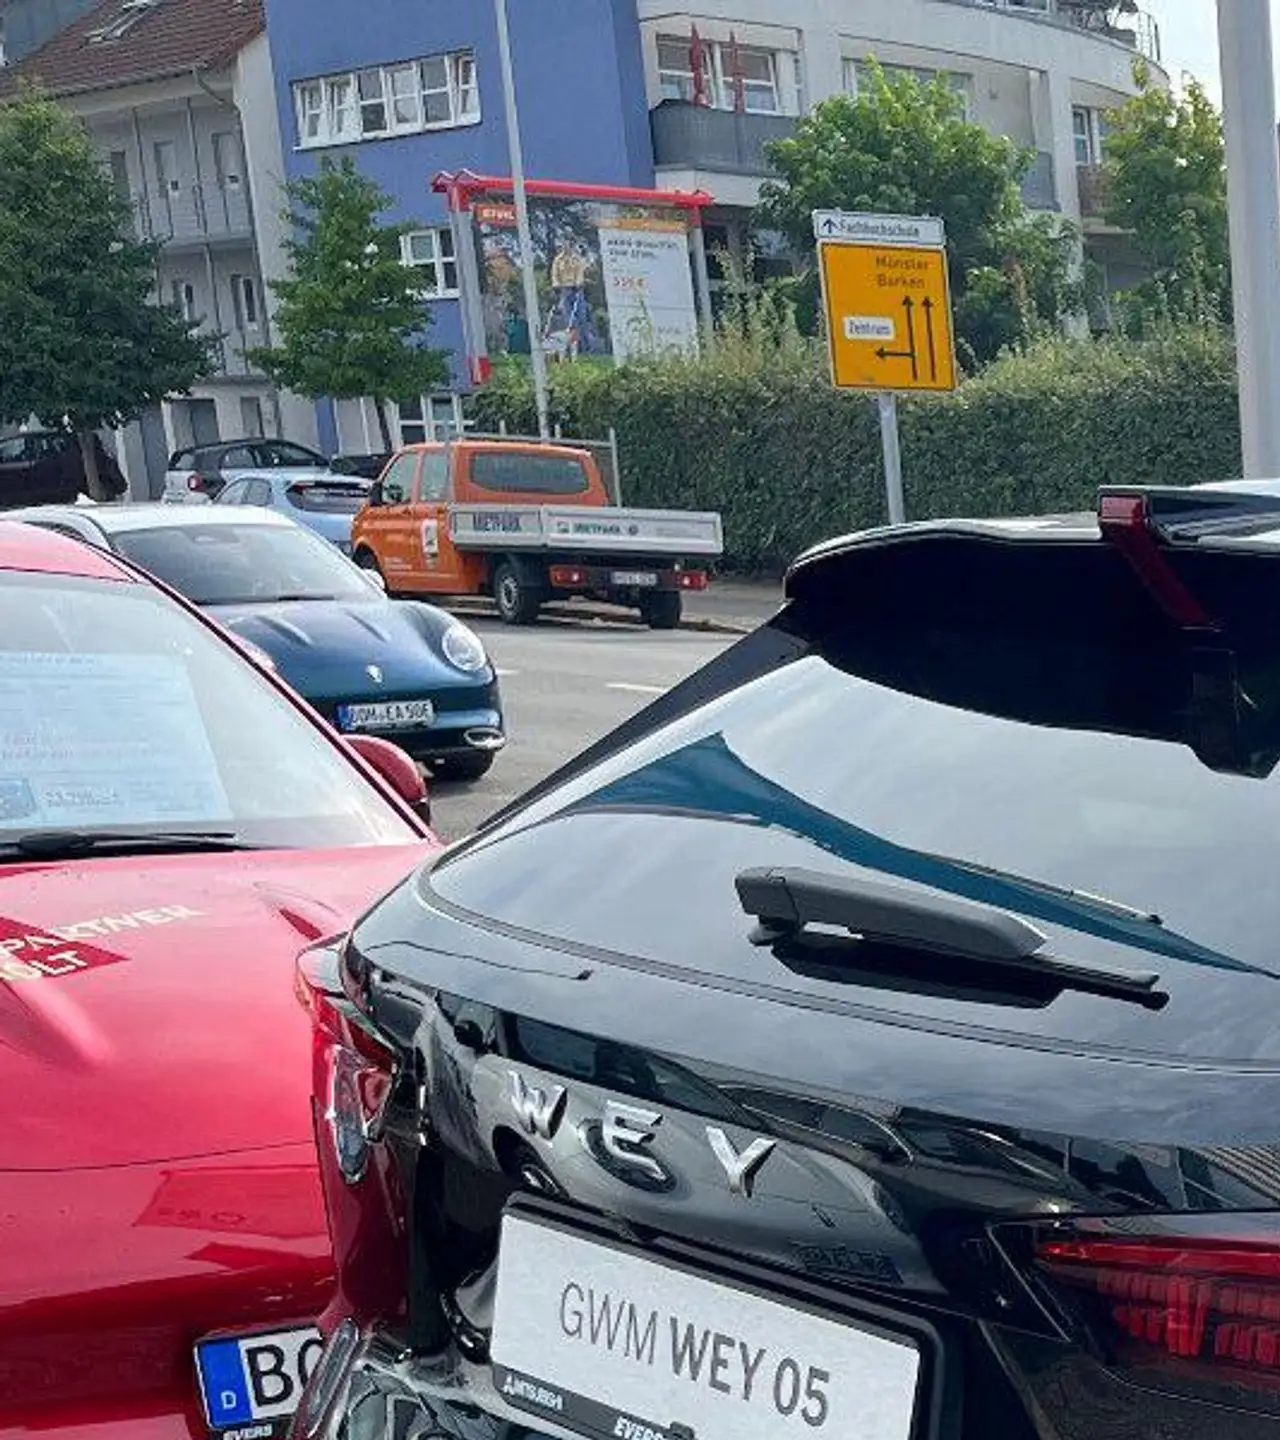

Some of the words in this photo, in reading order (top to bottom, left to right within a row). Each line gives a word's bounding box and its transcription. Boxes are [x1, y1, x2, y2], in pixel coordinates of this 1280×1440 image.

[508, 1070, 777, 1198] WEY
[221, 1390, 237, 1409] D
[560, 1281, 658, 1364] GWM
[670, 1316, 766, 1402] WEY
[773, 1356, 830, 1427] 05
